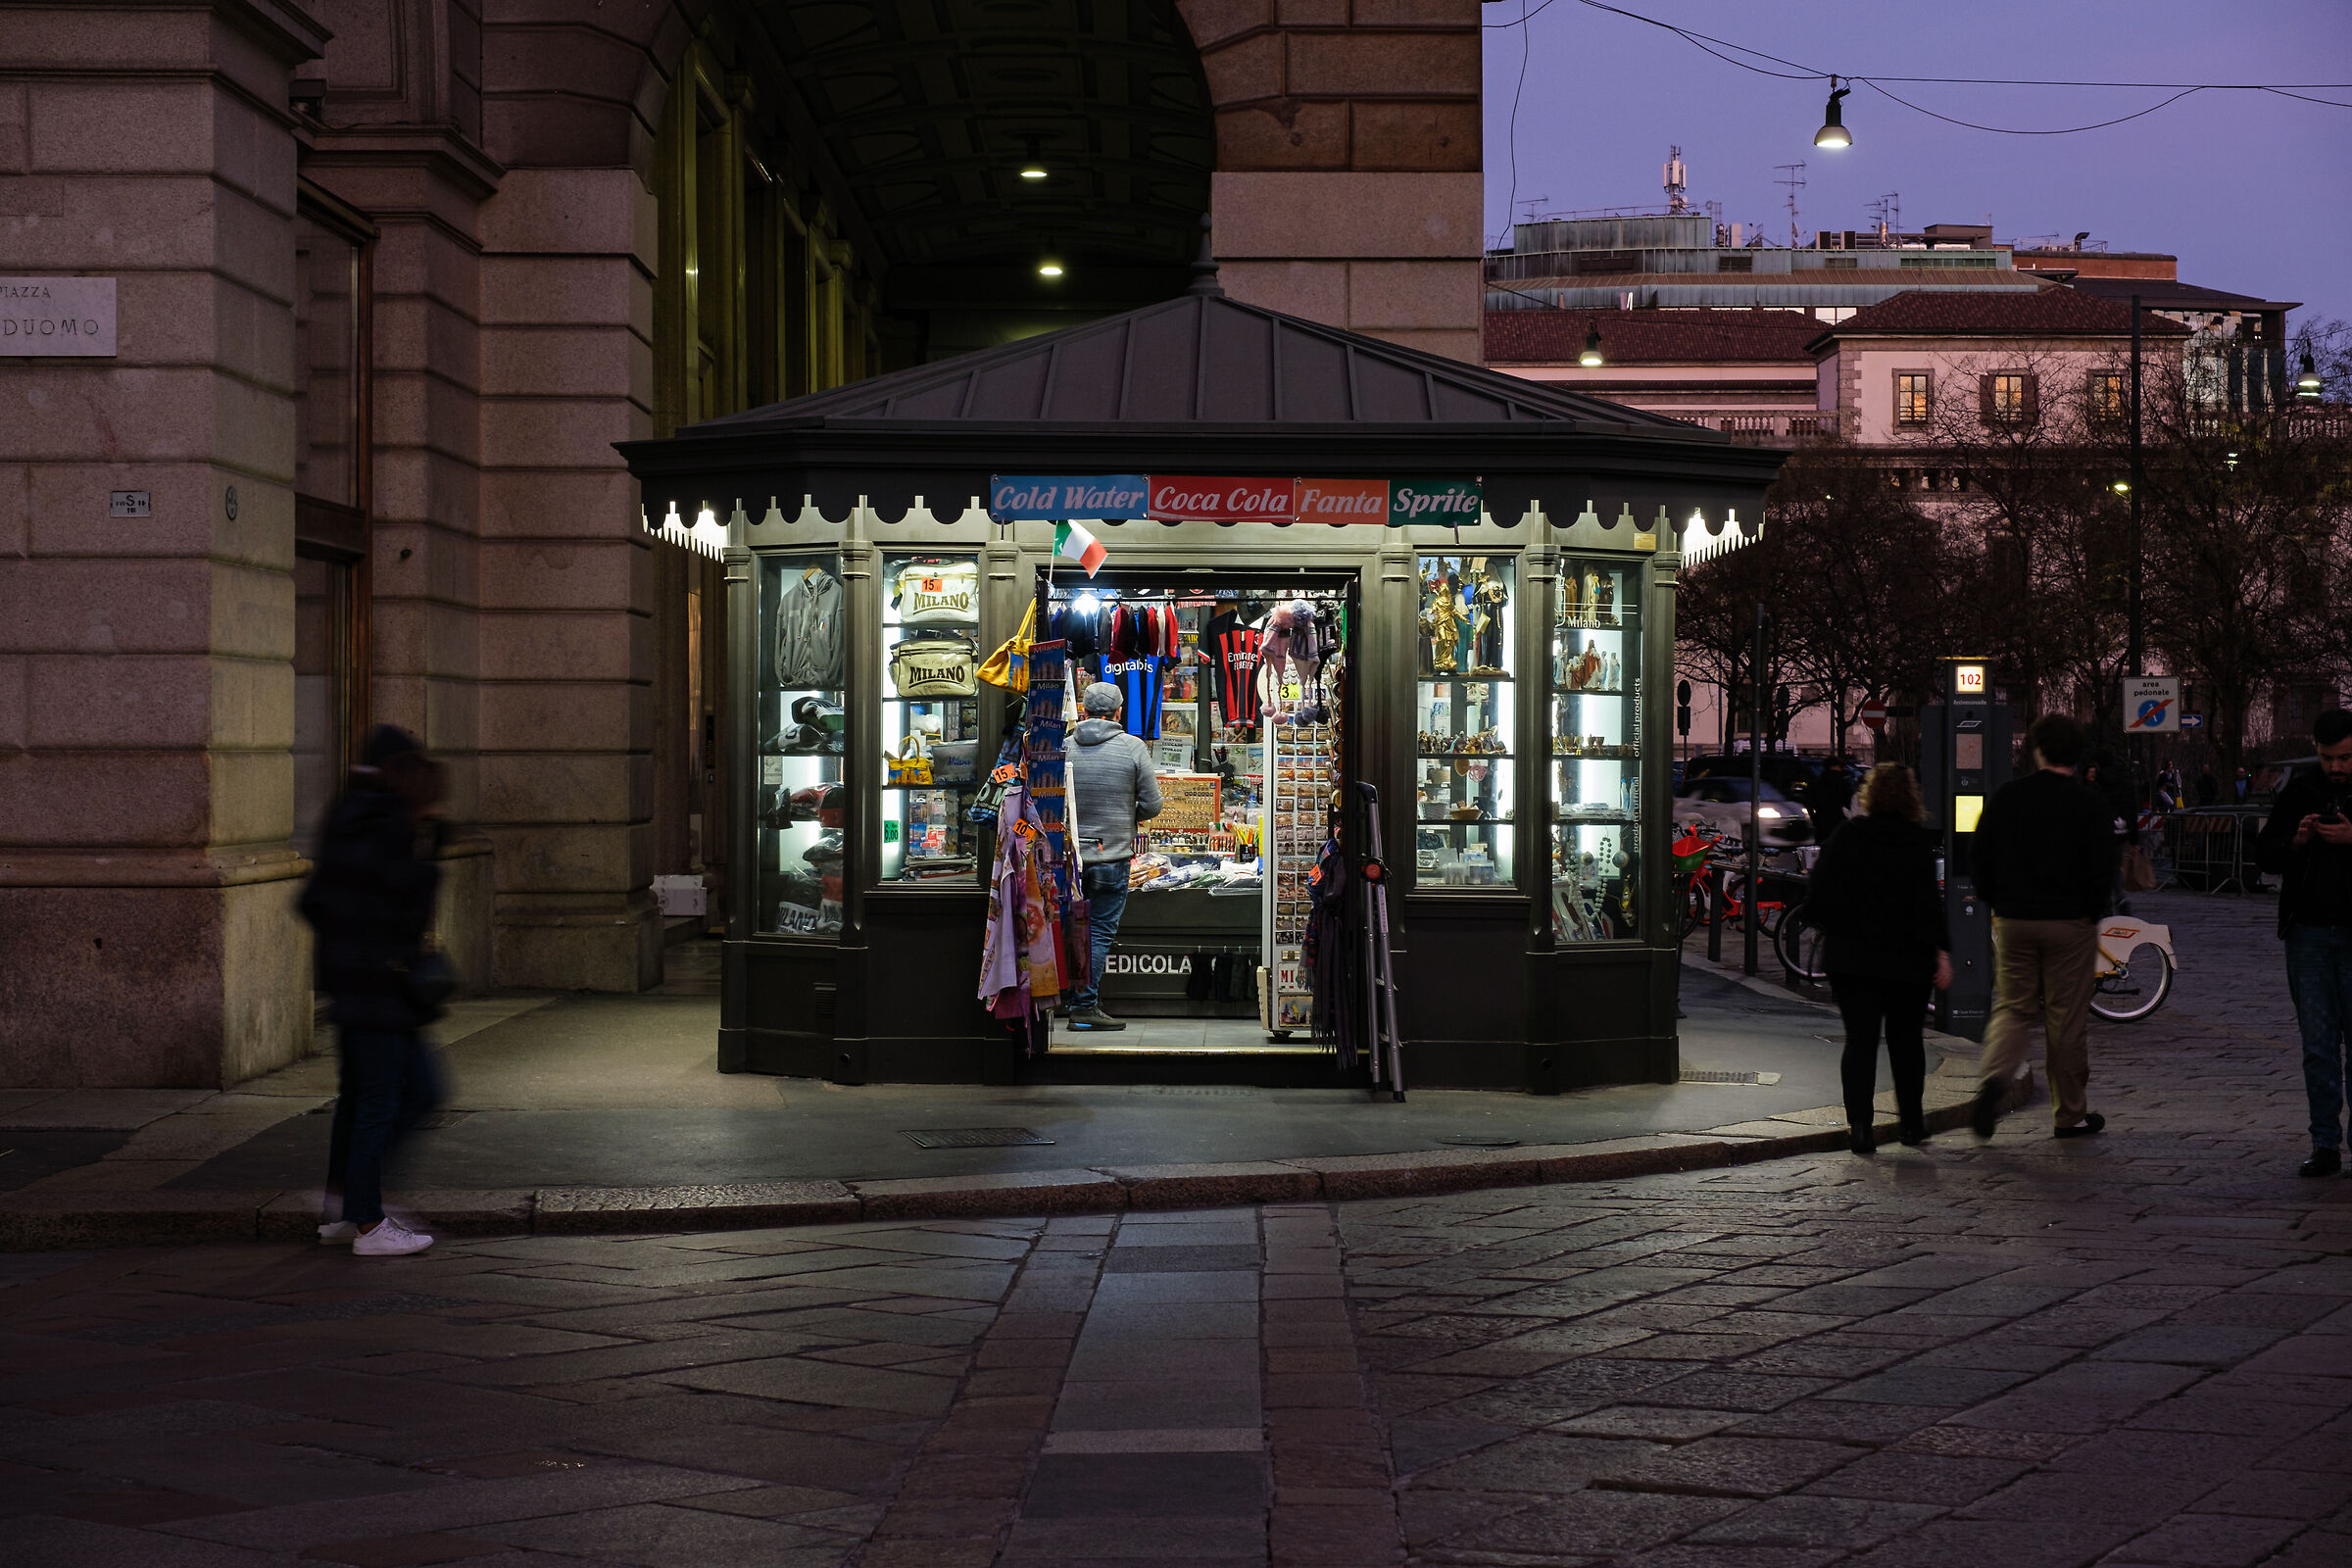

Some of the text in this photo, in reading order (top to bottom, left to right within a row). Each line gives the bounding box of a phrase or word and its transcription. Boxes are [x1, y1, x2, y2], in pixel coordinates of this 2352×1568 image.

[3, 318, 99, 336] DUOMO
[994, 485, 1145, 511] Cold Water
[1154, 486, 1289, 513] Coca Cola
[1299, 489, 1383, 514] Fanta
[1393, 486, 1479, 518] Sprite
[923, 579, 935, 591] 15
[912, 591, 969, 612] MILANO
[1567, 615, 1601, 629] Milano
[1033, 643, 1061, 654] Milano
[908, 664, 965, 685] MILANO
[1960, 673, 1982, 685] 102
[1282, 686, 1290, 699] 3
[2133, 688, 2170, 697] pedonale
[1039, 719, 1061, 730] Milan
[1037, 753, 1060, 762] Milan
[995, 768, 1008, 781] 15
[1016, 821, 1028, 835] 10
[1104, 954, 1193, 974] EDICOLA
